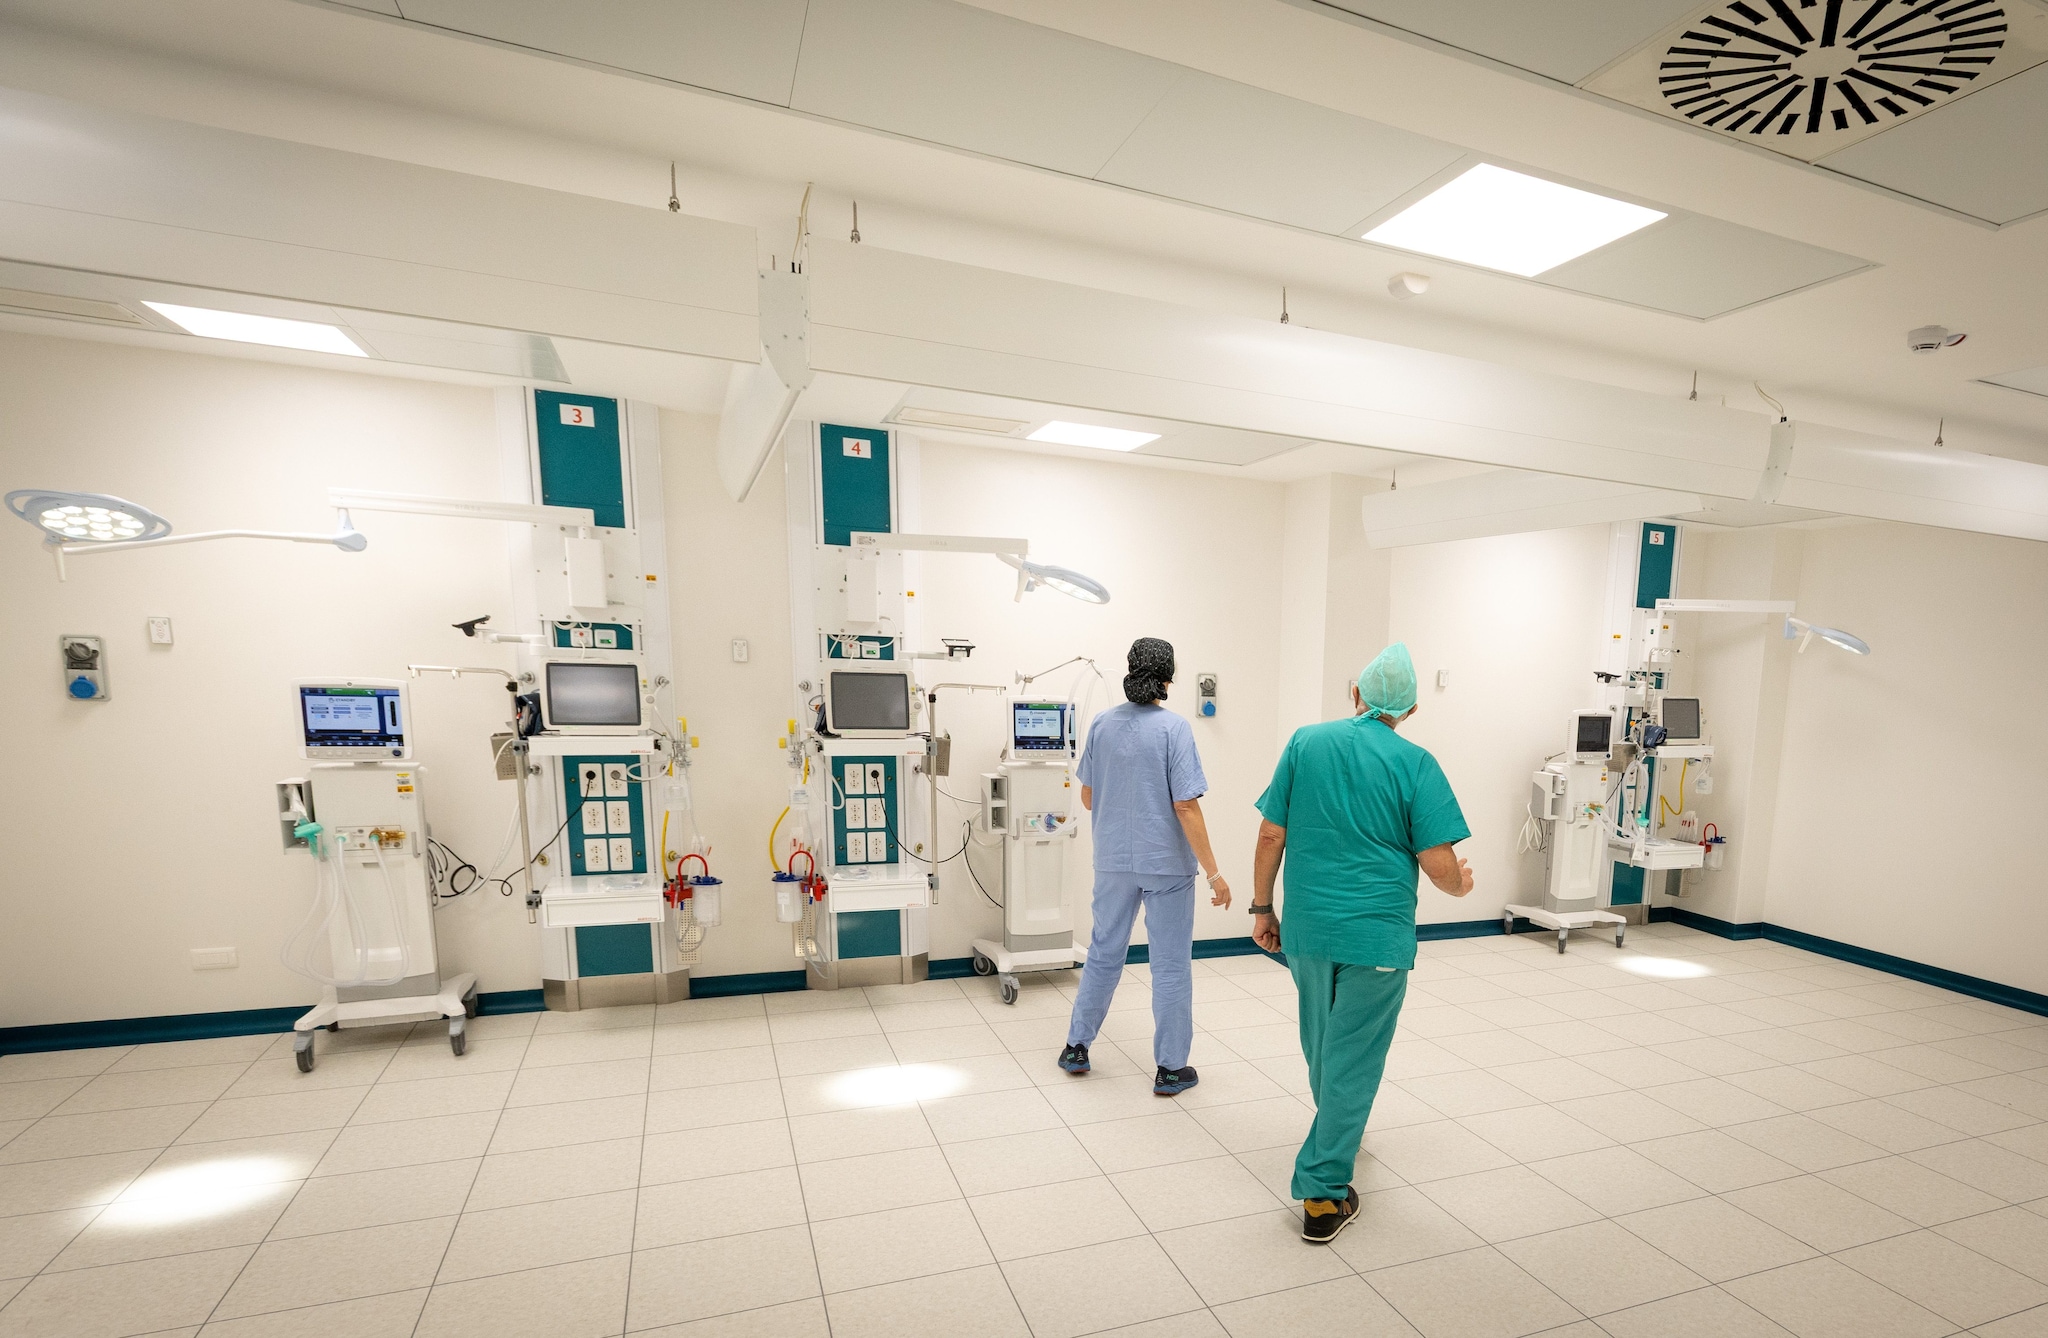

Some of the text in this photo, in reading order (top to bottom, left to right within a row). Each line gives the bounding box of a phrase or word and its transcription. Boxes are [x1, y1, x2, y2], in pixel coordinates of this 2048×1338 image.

[572, 408, 583, 424] 3
[851, 441, 862, 456] 4
[1653, 533, 1660, 544] 5
